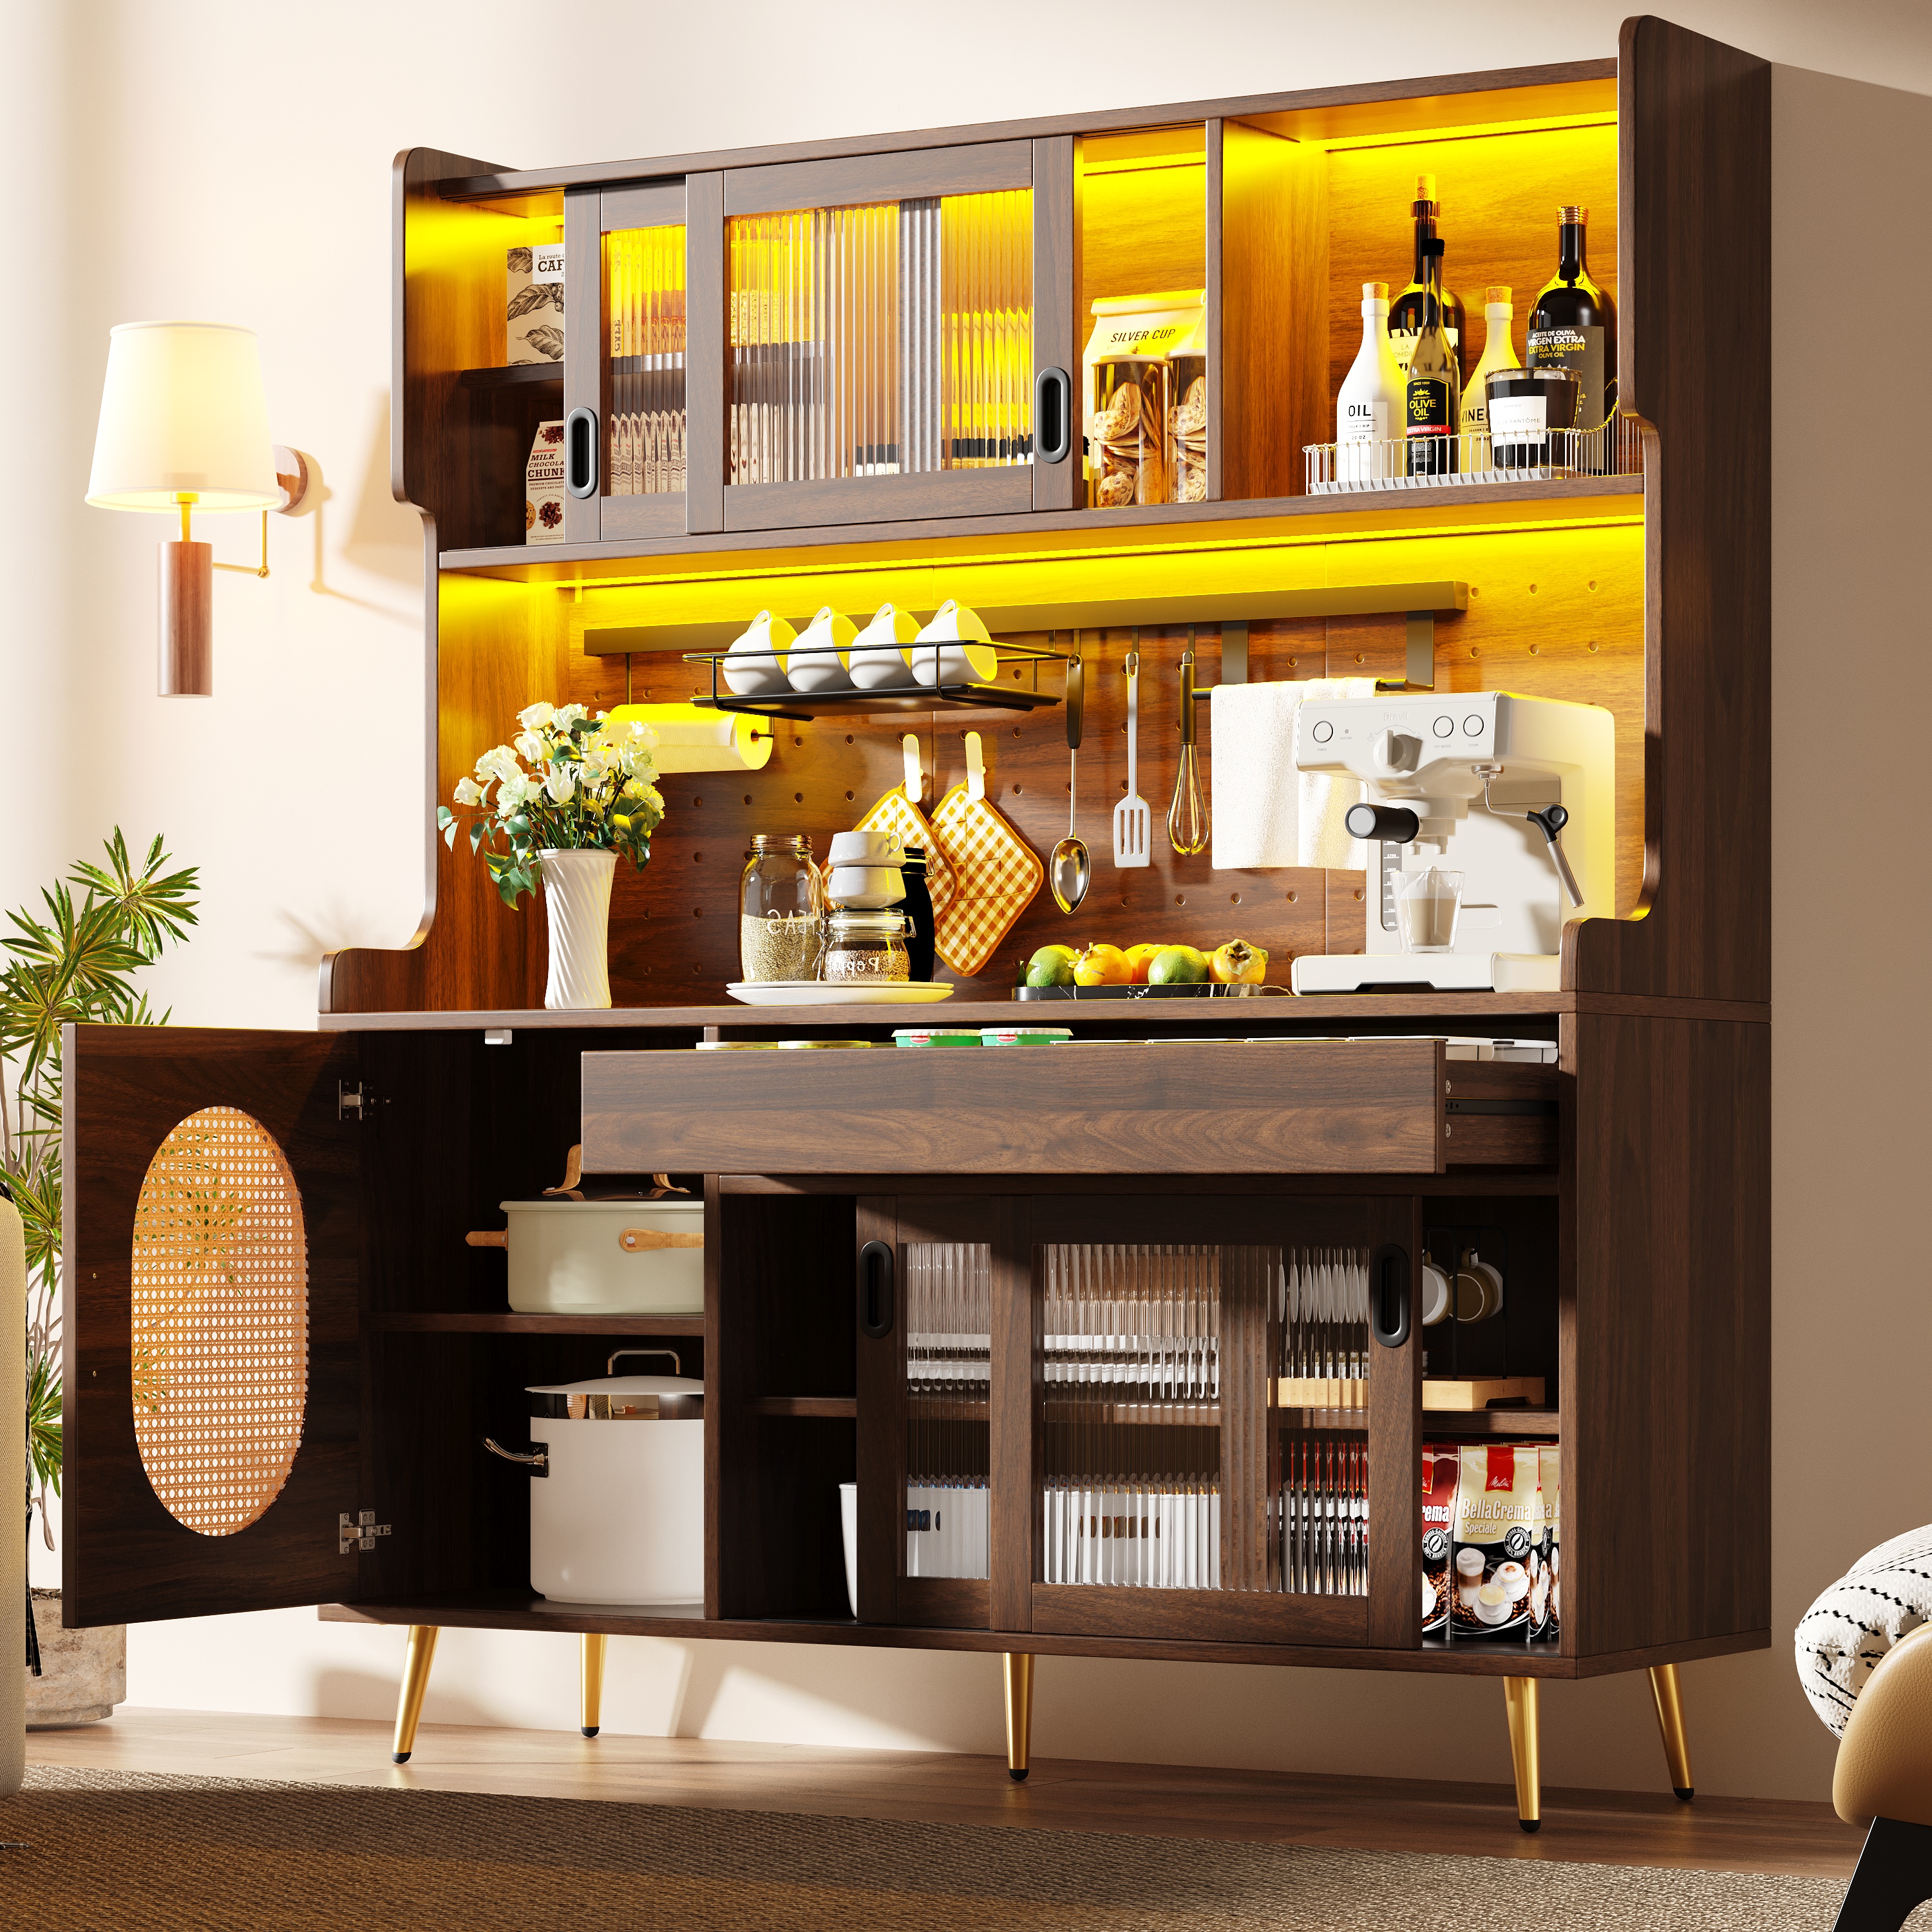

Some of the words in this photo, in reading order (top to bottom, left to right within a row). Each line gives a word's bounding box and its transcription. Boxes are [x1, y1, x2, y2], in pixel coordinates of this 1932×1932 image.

[1110, 330, 1149, 343] SILVER
[1151, 328, 1176, 339] CUP
[1528, 337, 1552, 347] VIRGEN
[1553, 335, 1586, 344] EXTRA
[1529, 345, 1549, 355] EXTRA
[1550, 343, 1585, 352] VIRGIN
[1349, 404, 1371, 417] OIL
[1409, 399, 1437, 410] OLIVE
[1413, 408, 1430, 417] OIL
[1461, 1497, 1531, 1520] BellaCrema
[1464, 1522, 1497, 1535] Speciale
